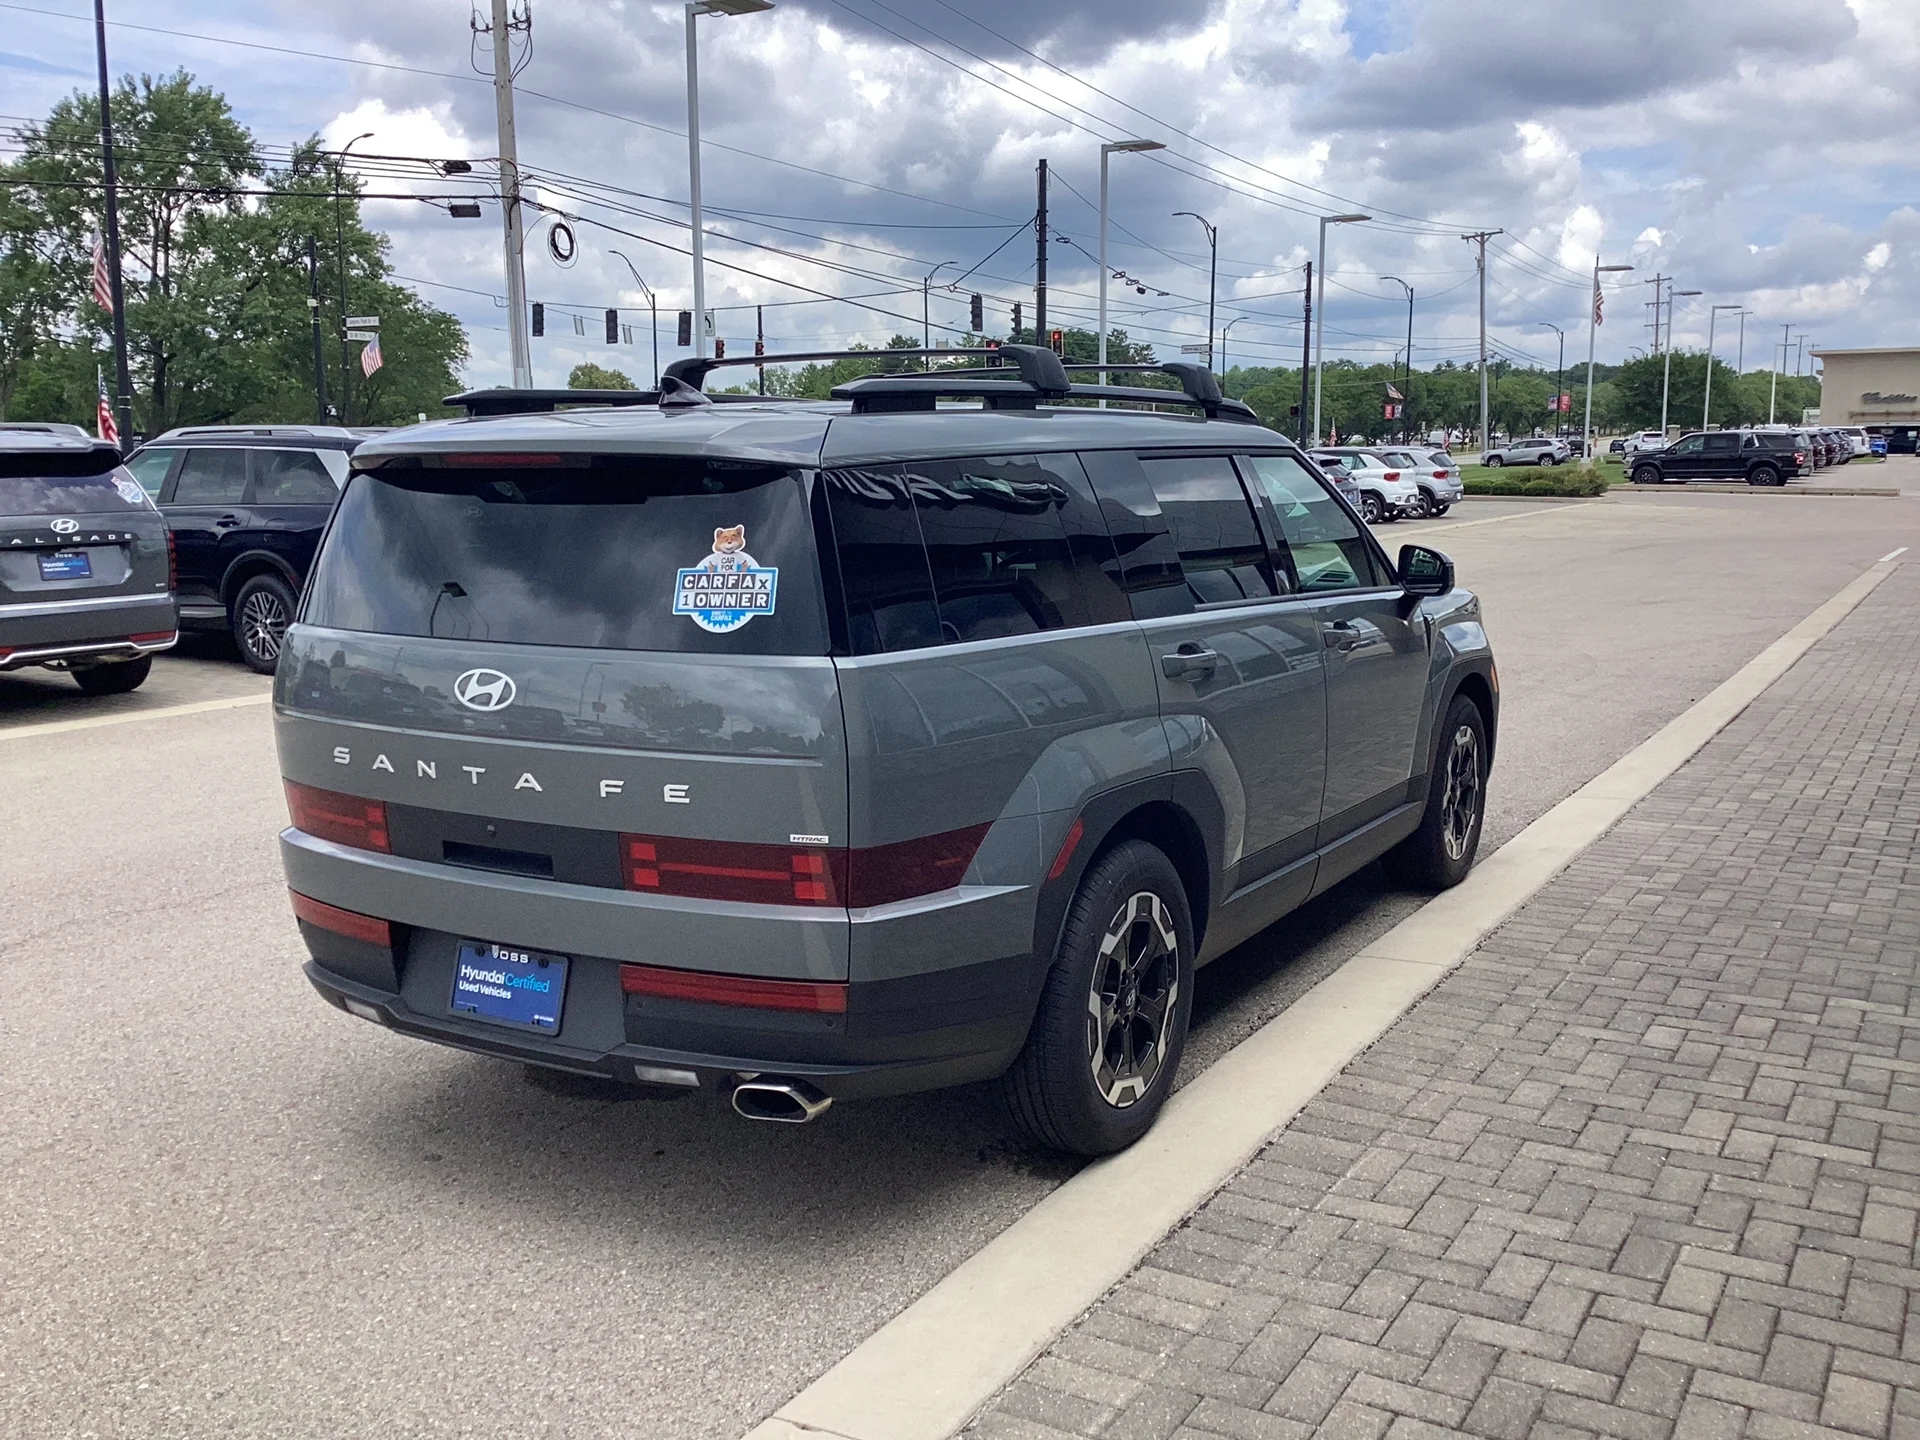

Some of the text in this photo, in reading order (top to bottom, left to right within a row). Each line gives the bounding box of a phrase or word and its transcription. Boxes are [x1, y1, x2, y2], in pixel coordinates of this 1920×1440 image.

[0, 533, 132, 544] ALISADE
[683, 575, 769, 590] CARFAX
[682, 594, 768, 607] 1 OWNER
[333, 746, 691, 804] SANTA FE
[461, 965, 505, 984] Hyundai
[459, 980, 511, 999] Used Vehicles
